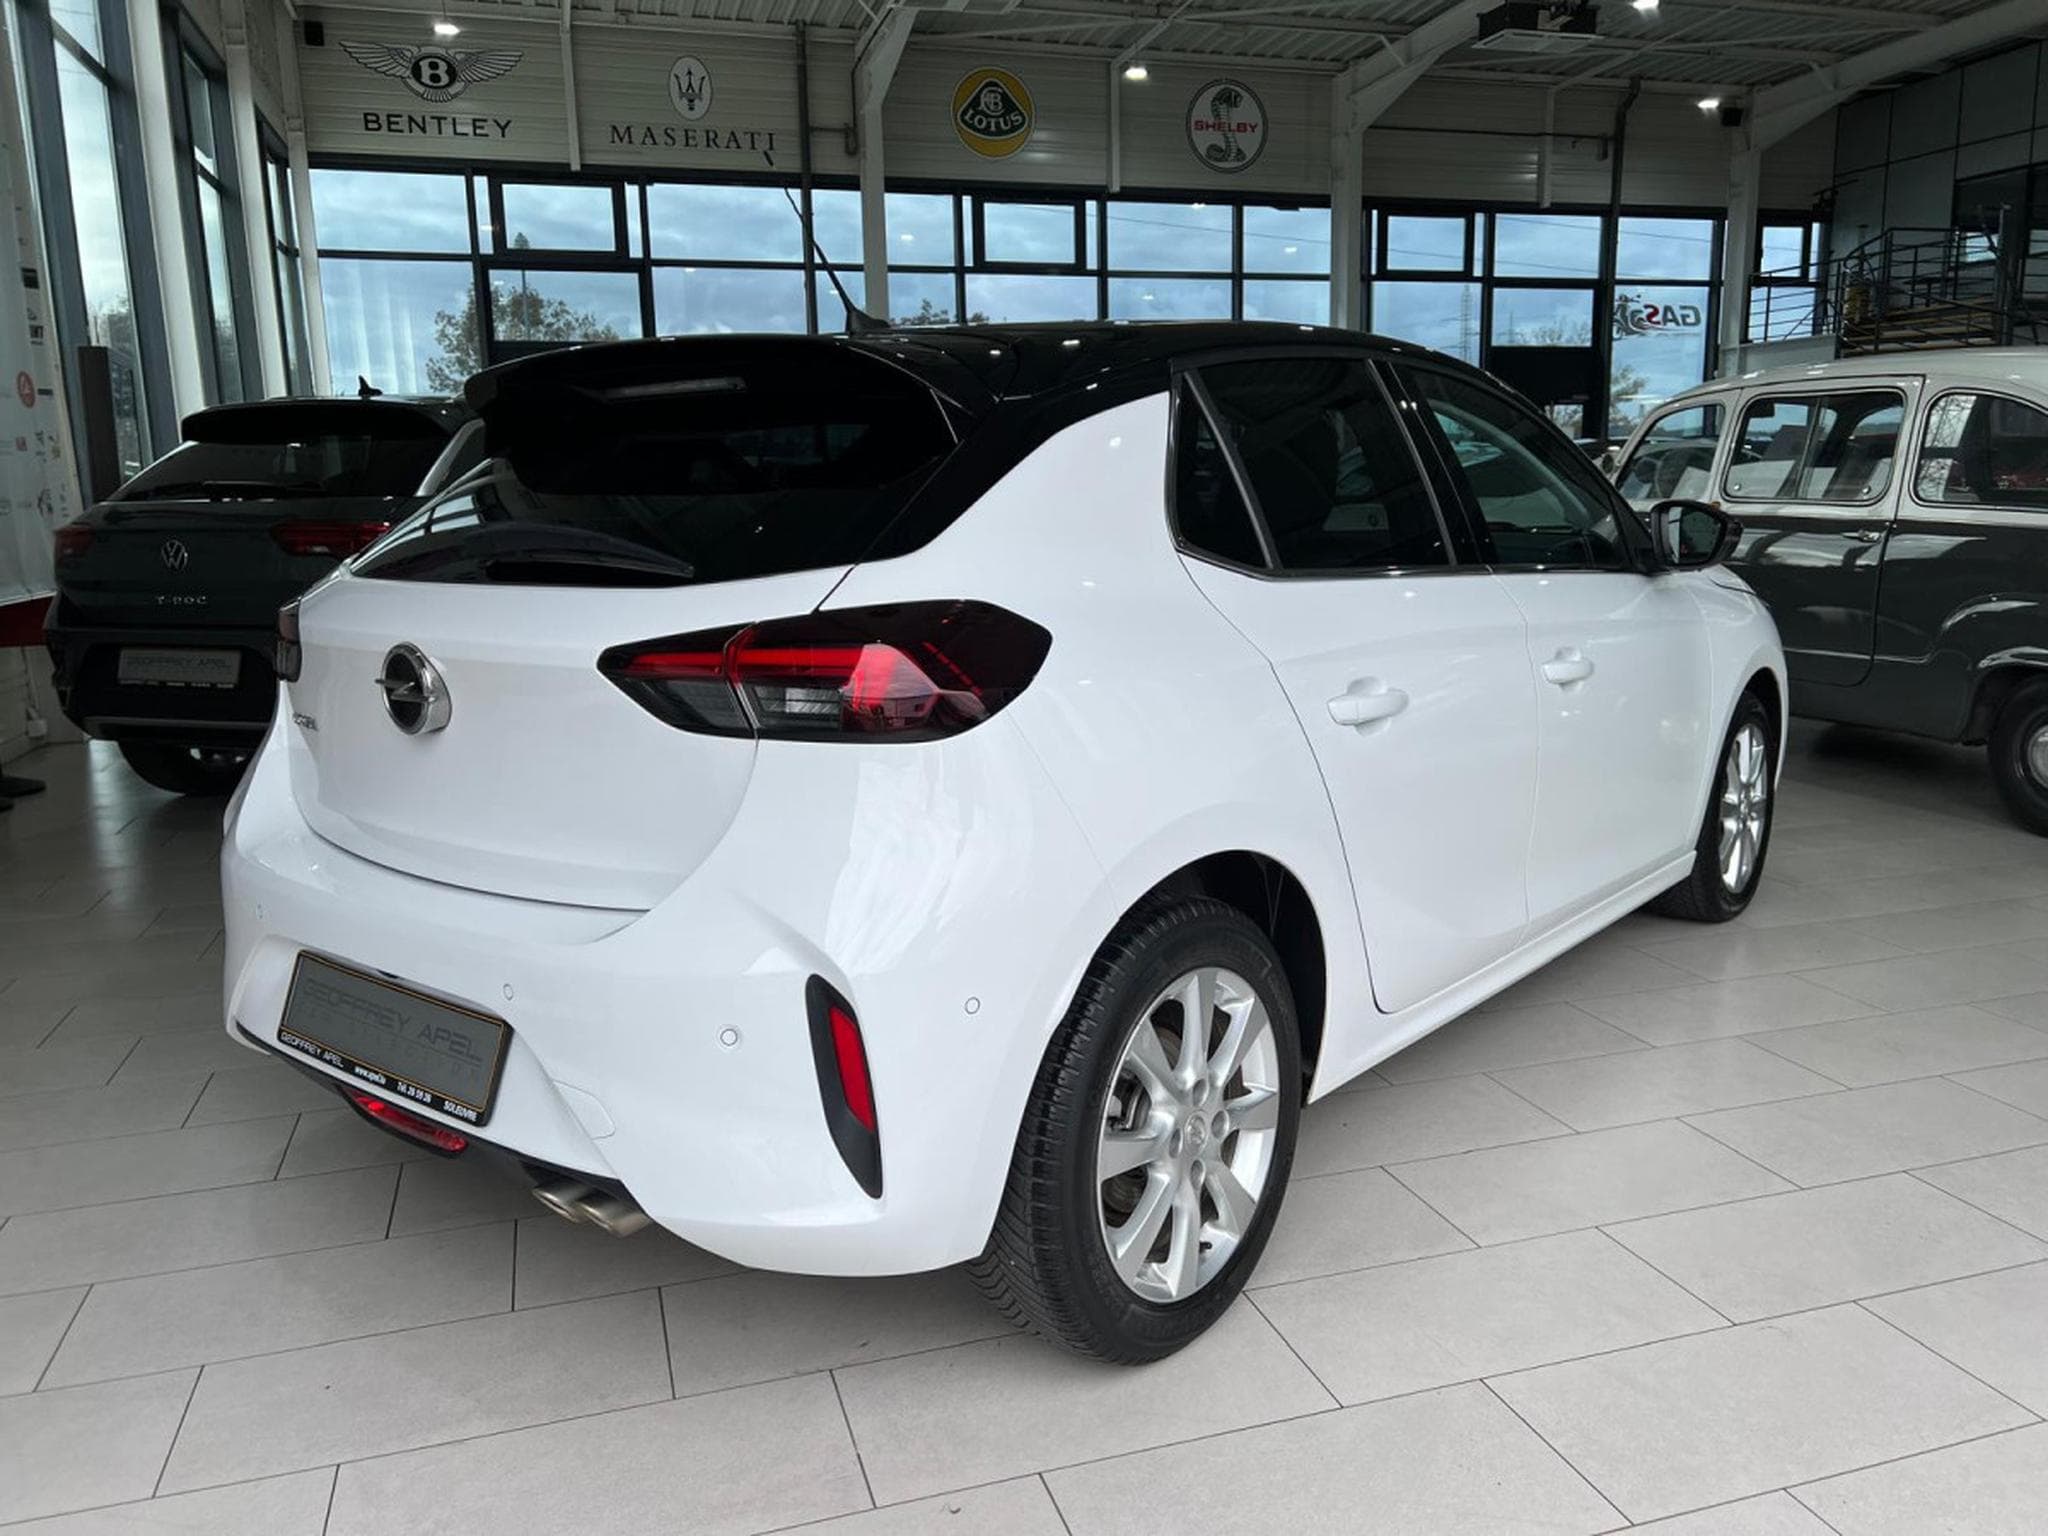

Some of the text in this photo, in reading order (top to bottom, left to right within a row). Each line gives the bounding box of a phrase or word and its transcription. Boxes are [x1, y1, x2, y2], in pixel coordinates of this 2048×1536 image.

[363, 114, 513, 138] BENTLEY
[964, 109, 1023, 132] LOTUS
[1194, 120, 1258, 133] SHELBY
[611, 124, 776, 151] MASERATI
[303, 977, 411, 1030] GEOFFREY
[417, 1023, 483, 1062] APEL
